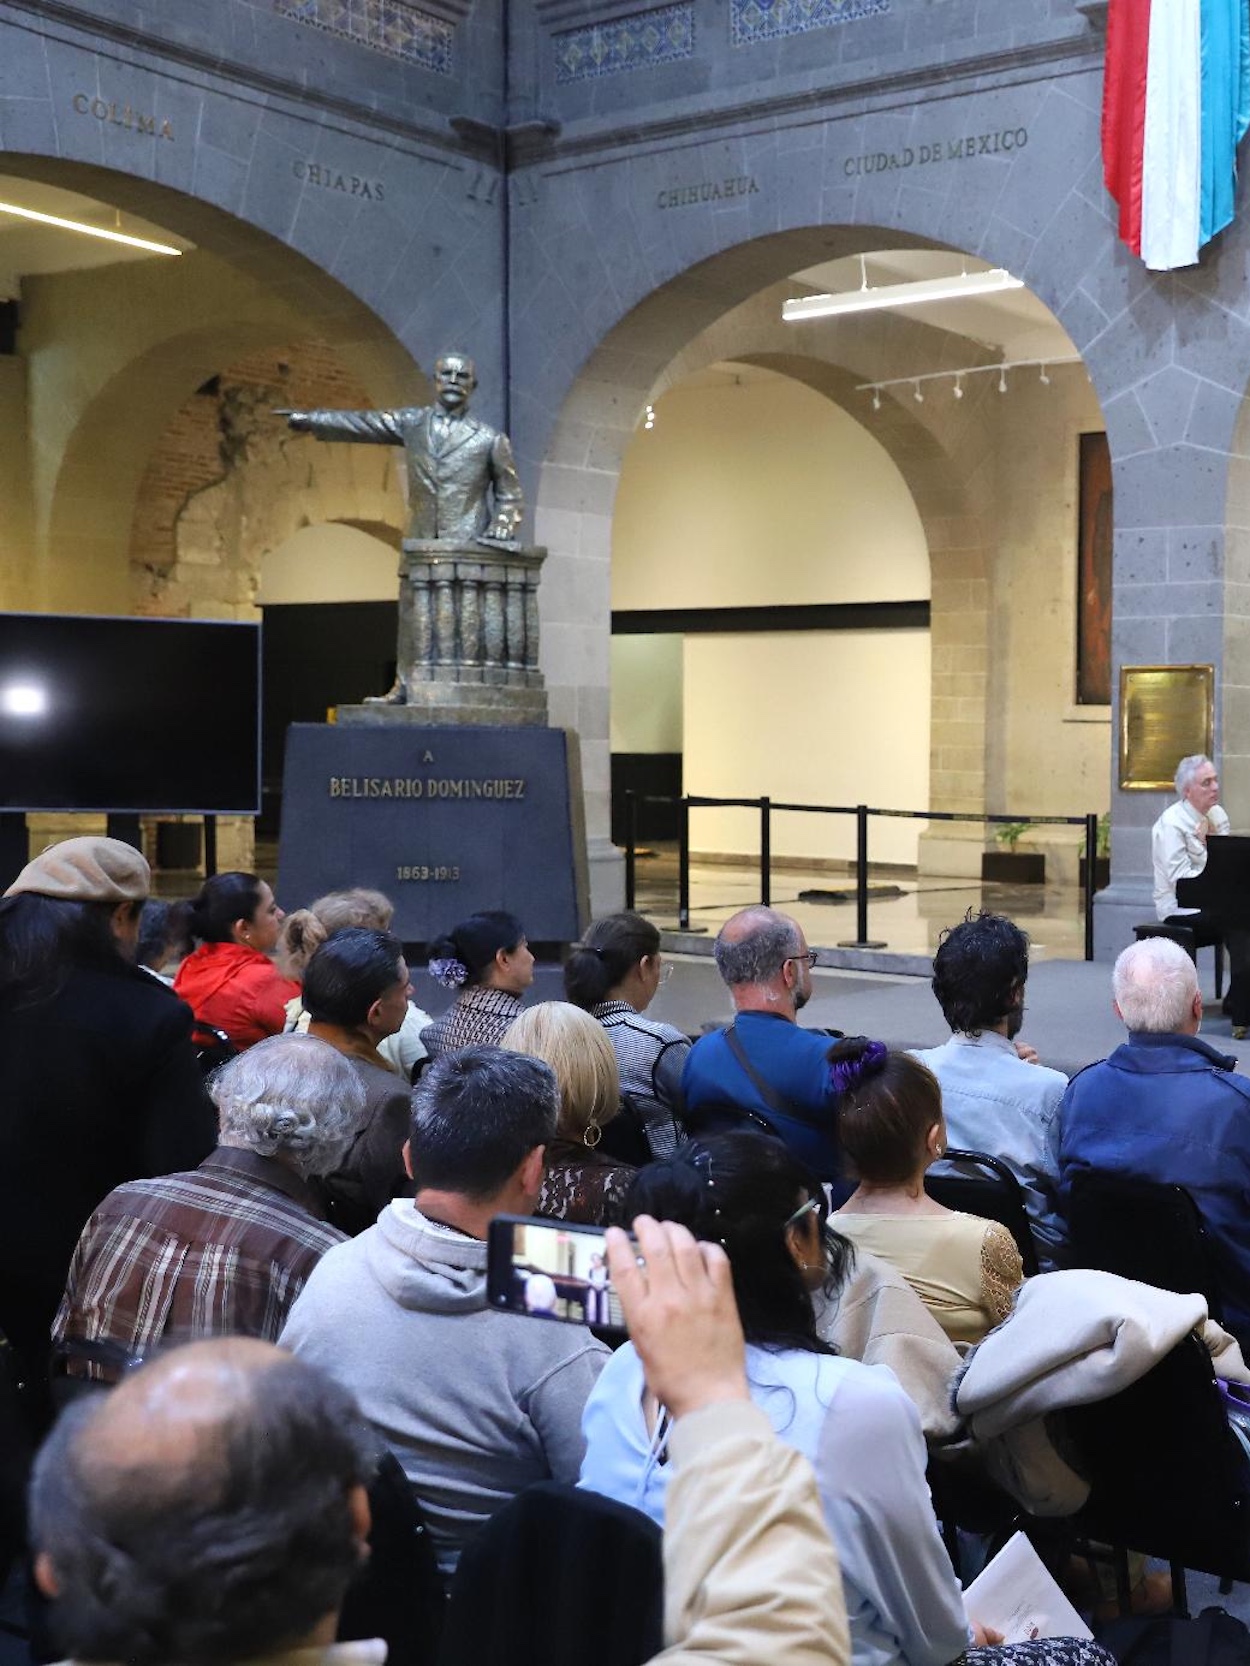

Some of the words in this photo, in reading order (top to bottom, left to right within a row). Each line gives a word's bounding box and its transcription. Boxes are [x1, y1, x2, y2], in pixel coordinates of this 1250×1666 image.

[72, 94, 175, 142] COLIMA
[844, 147, 914, 177] CIUDAD
[919, 142, 943, 165] DE
[948, 127, 1028, 161] MEXICO
[292, 160, 385, 202] CHIAPAS
[657, 175, 760, 210] CHIHUAHUA
[423, 750, 434, 763] A
[329, 777, 423, 798] BELISARIO
[427, 778, 525, 799] DOMINGUEZ
[397, 865, 460, 881] 1863-1913
